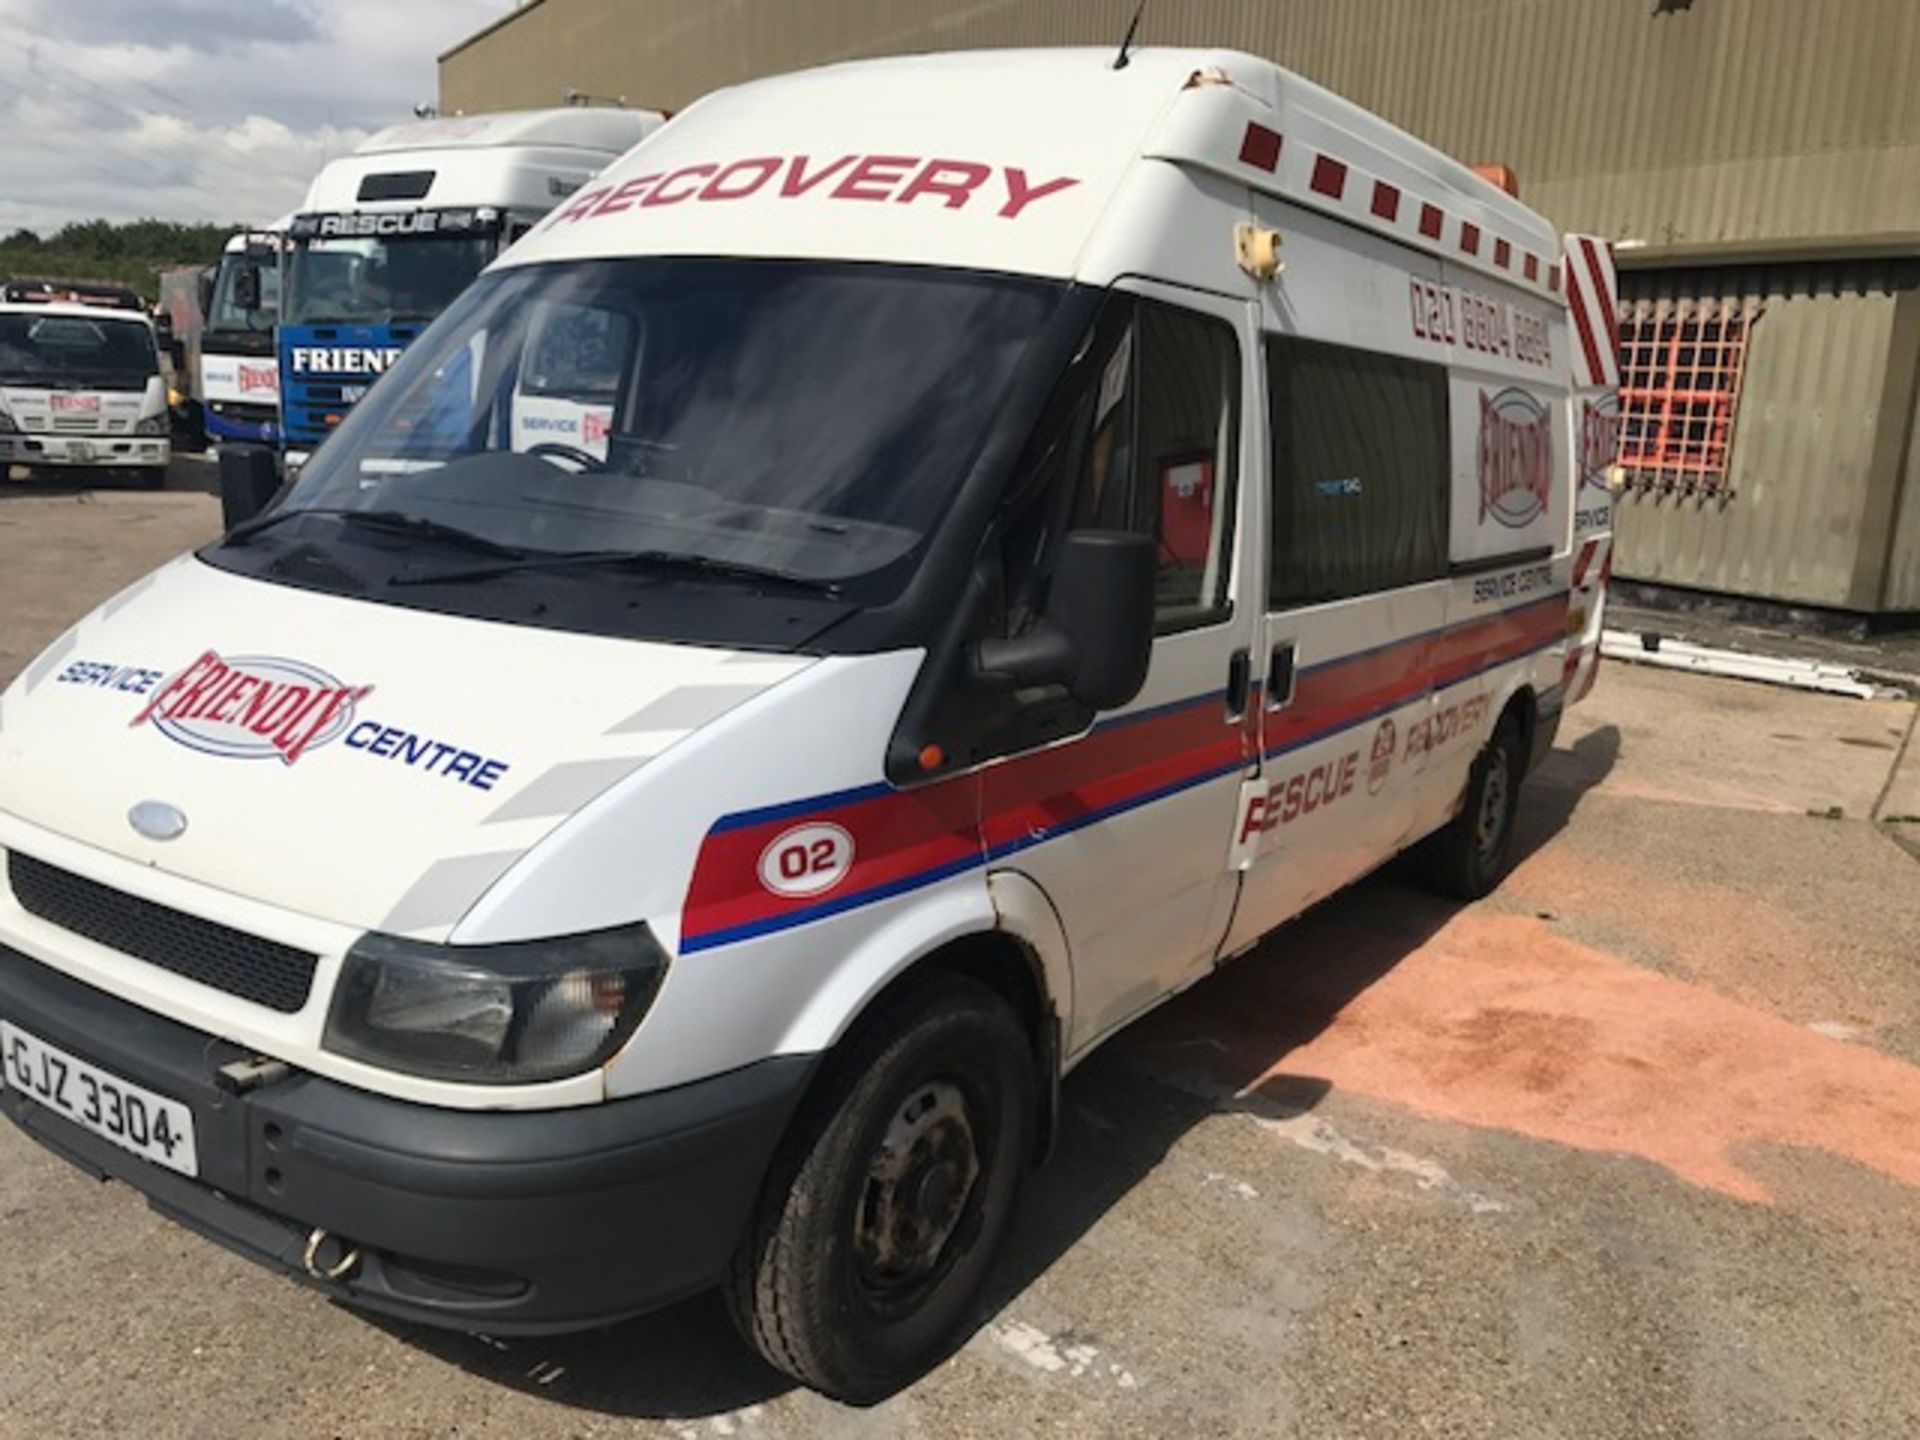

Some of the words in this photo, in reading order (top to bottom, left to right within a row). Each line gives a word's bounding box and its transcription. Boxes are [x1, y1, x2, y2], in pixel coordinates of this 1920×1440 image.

[543, 154, 1082, 232] RECOVERY
[321, 213, 437, 236] RESCUE
[522, 416, 577, 433] SERVICE
[57, 660, 163, 694] SERVICE
[128, 648, 376, 766] FRIENDLY
[344, 722, 509, 791] CENTRE
[779, 839, 836, 879] 02
[13, 1037, 73, 1111] GJZ
[80, 1073, 174, 1158] 3304
